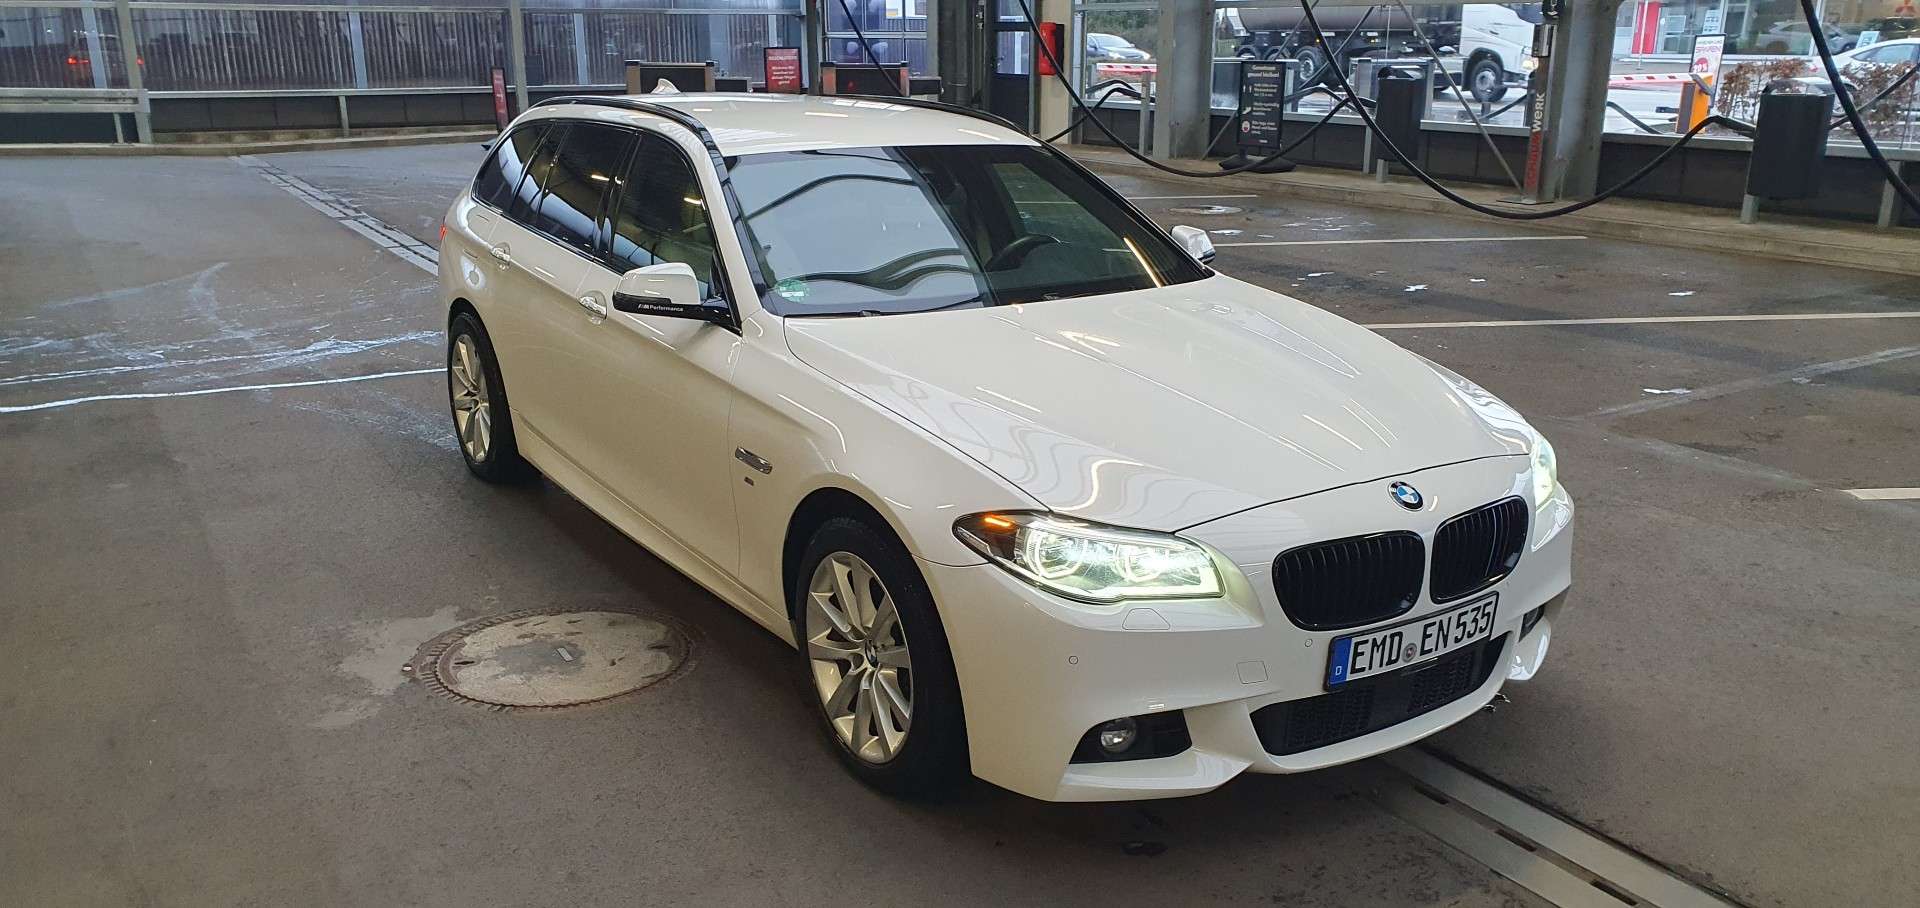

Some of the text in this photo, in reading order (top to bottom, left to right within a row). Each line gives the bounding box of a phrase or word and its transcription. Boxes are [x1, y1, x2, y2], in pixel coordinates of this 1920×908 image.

[1349, 600, 1494, 675] EMD EN 535
[1335, 665, 1342, 676] D
